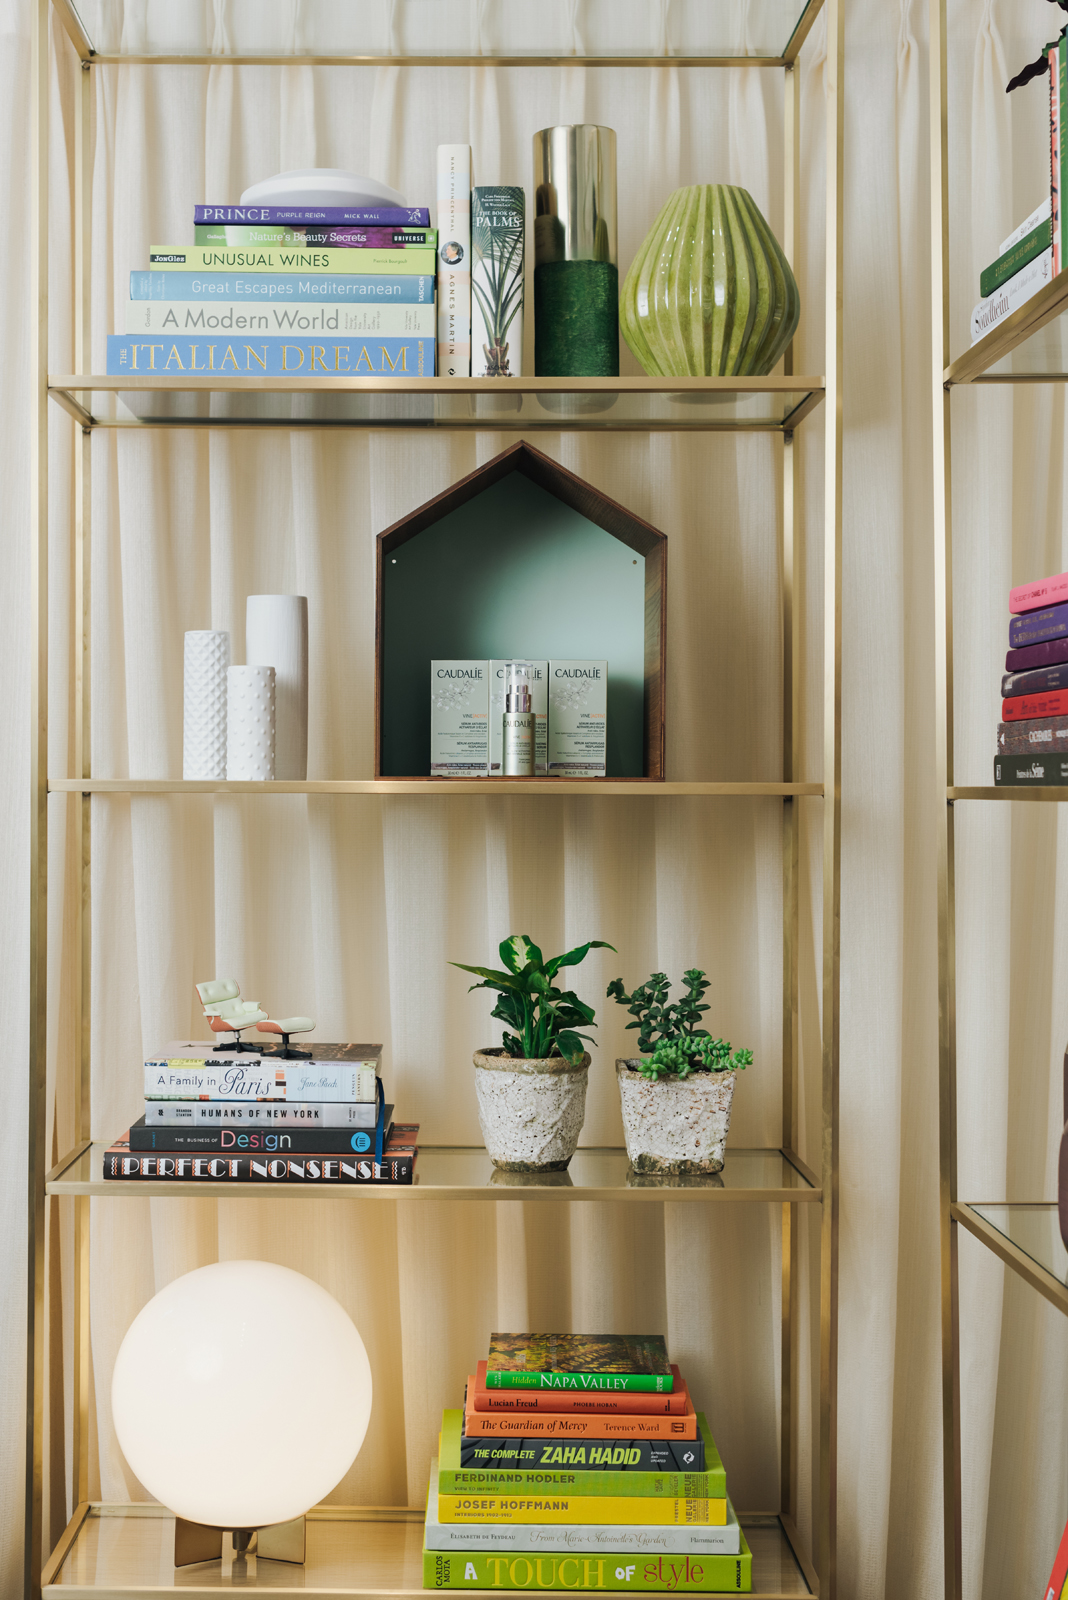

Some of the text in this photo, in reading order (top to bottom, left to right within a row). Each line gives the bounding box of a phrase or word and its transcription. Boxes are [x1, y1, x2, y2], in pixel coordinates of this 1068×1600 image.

[203, 208, 270, 220] PRINCE
[476, 216, 520, 227] PALMS
[250, 232, 366, 243] Nature's Beauty Secrets
[203, 253, 329, 266] UNUSUAL WINES
[192, 280, 401, 297] Great Escapes Mediterranean
[162, 308, 338, 330] A Modern World
[129, 344, 409, 372] ITALIAN DREAM
[158, 1068, 272, 1095] A Family in Paris
[298, 1077, 317, 1091] Jane
[201, 1109, 242, 1117] HUMANS
[294, 1110, 319, 1118] YORK
[221, 1130, 291, 1150] Design
[121, 1157, 242, 1177] PERFECT
[250, 1159, 388, 1180] NONSENSE
[540, 1374, 578, 1387] NAPA
[580, 1375, 629, 1389] VALLEY
[516, 1399, 538, 1407] Freud
[480, 1420, 588, 1433] The Guardian of Mercy
[604, 1423, 660, 1432] Terence Ward
[474, 1446, 641, 1465] THE COMPLETE ZAHA HADID
[455, 1474, 575, 1484] FERDINAND HODLER
[455, 1500, 569, 1510] JOSEF HOFFMANN
[530, 1531, 555, 1542] From
[634, 1533, 667, 1548] Garden
[464, 1556, 704, 1590] A TOUCH OF style
